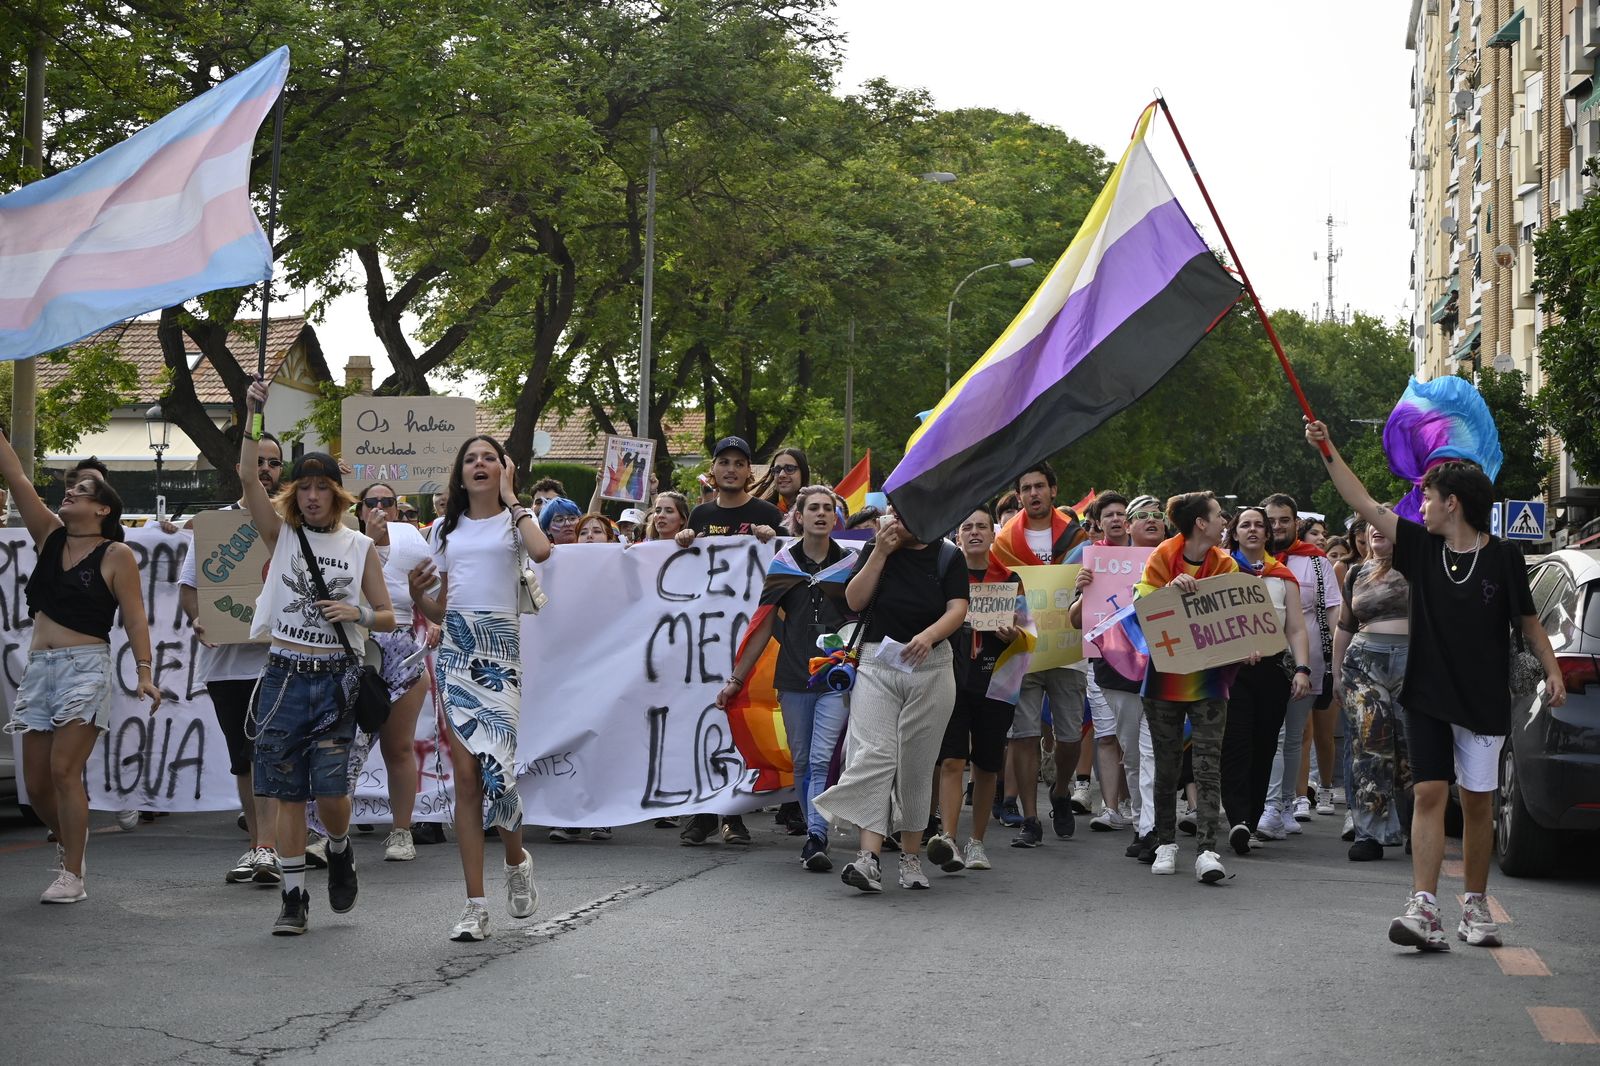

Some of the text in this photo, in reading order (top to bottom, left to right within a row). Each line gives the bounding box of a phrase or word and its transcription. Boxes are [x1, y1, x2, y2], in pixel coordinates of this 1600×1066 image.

[357, 409, 389, 432] Os
[422, 443, 435, 454] de
[353, 463, 456, 480] TRANS migrant
[202, 520, 258, 583] Gitan
[314, 556, 349, 571] NGELS
[214, 595, 254, 625] DOB
[1181, 585, 1266, 619] FRONTERAS
[1189, 612, 1277, 650] BOLLERAS
[646, 610, 751, 684] ME
